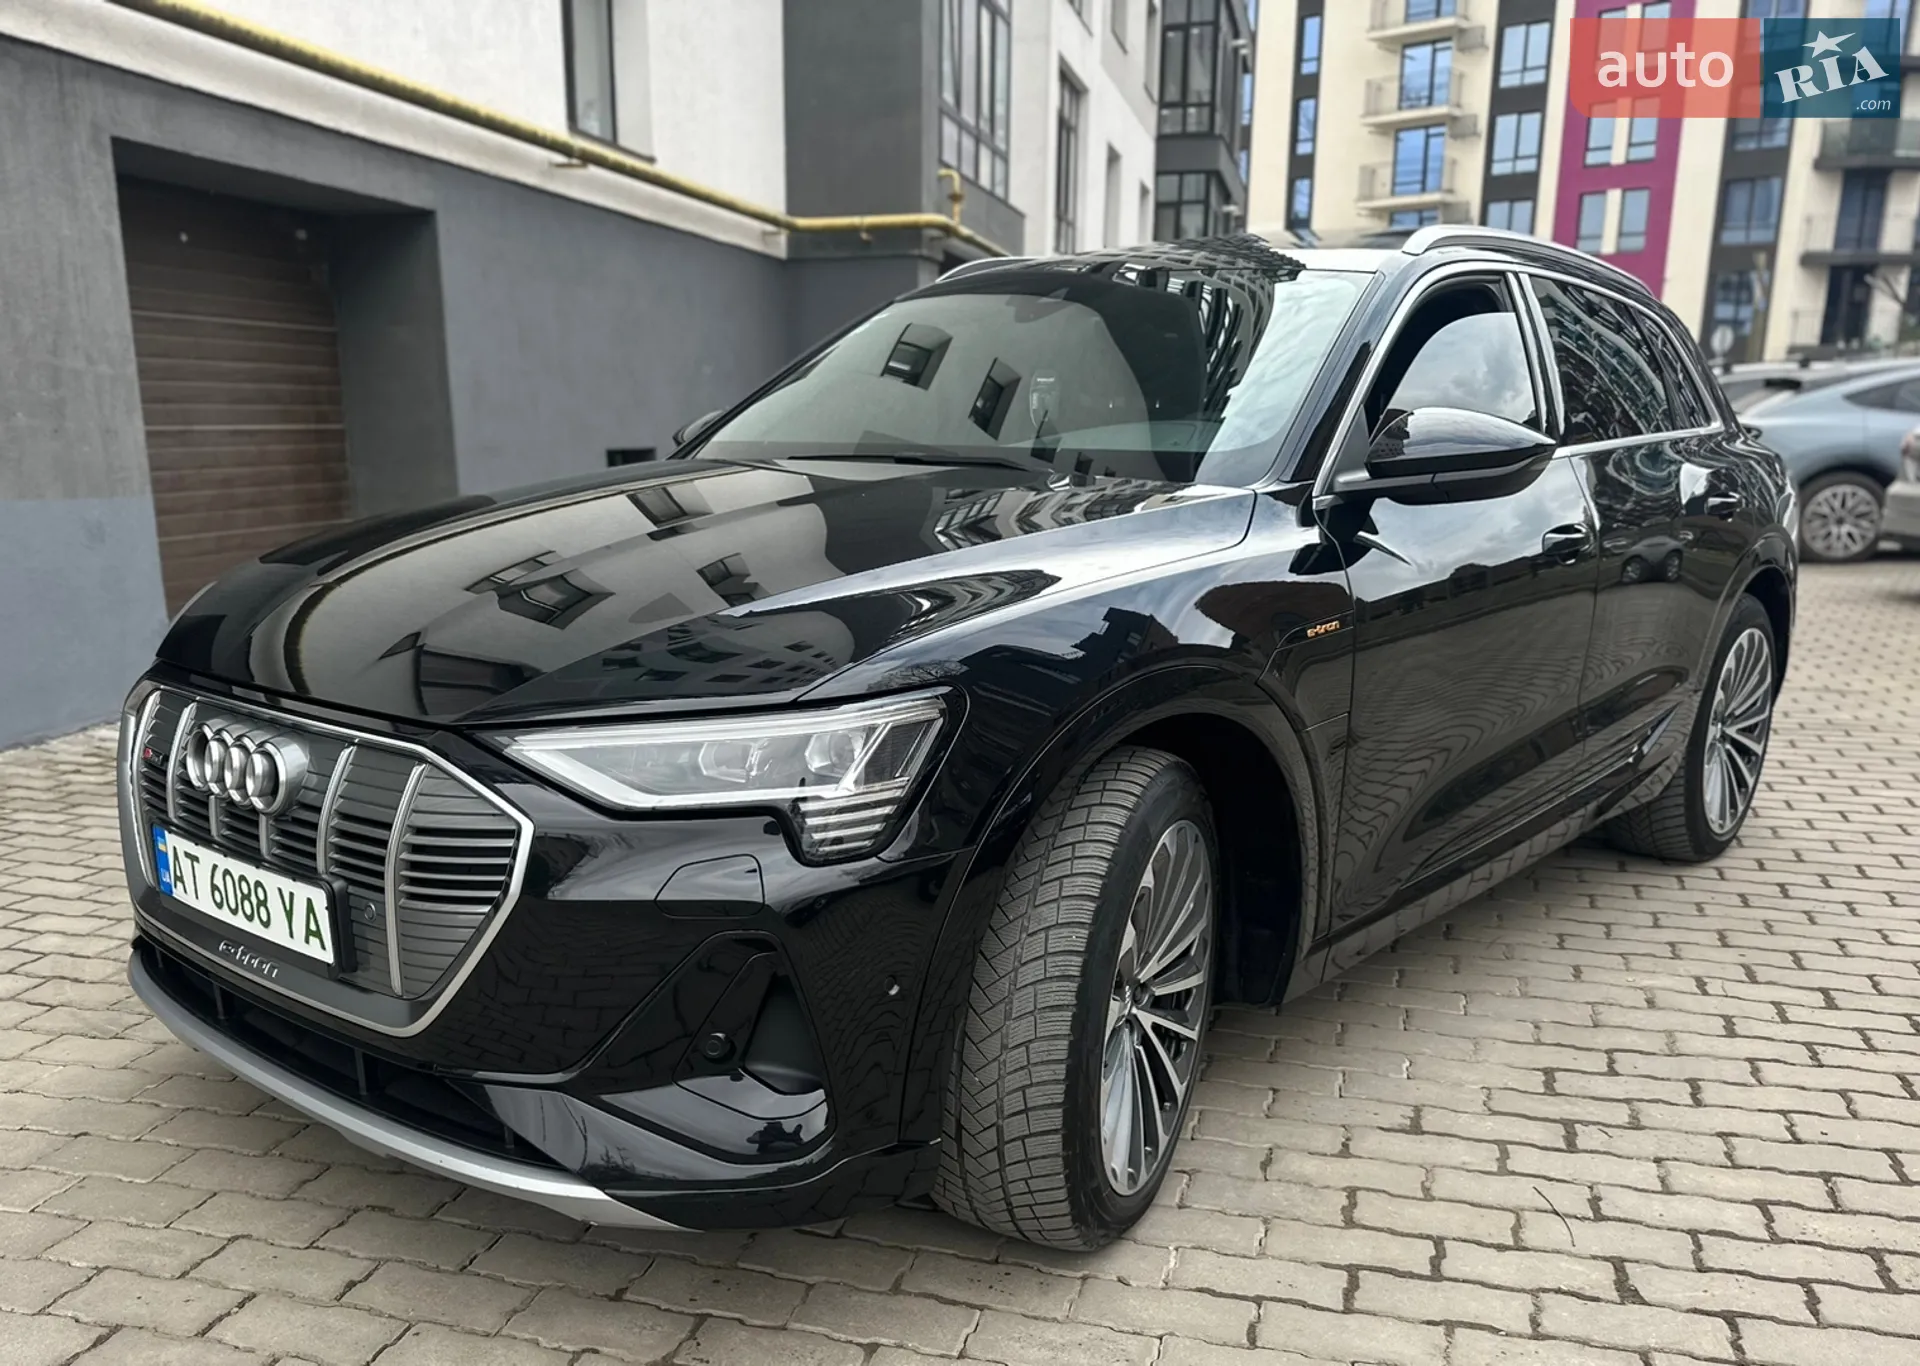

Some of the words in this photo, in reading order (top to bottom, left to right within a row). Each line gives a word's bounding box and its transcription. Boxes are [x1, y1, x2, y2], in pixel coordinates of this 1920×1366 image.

[1307, 620, 1340, 637] e-tron
[173, 845, 200, 900] AT
[210, 863, 271, 929] 6088
[277, 886, 326, 952] YA
